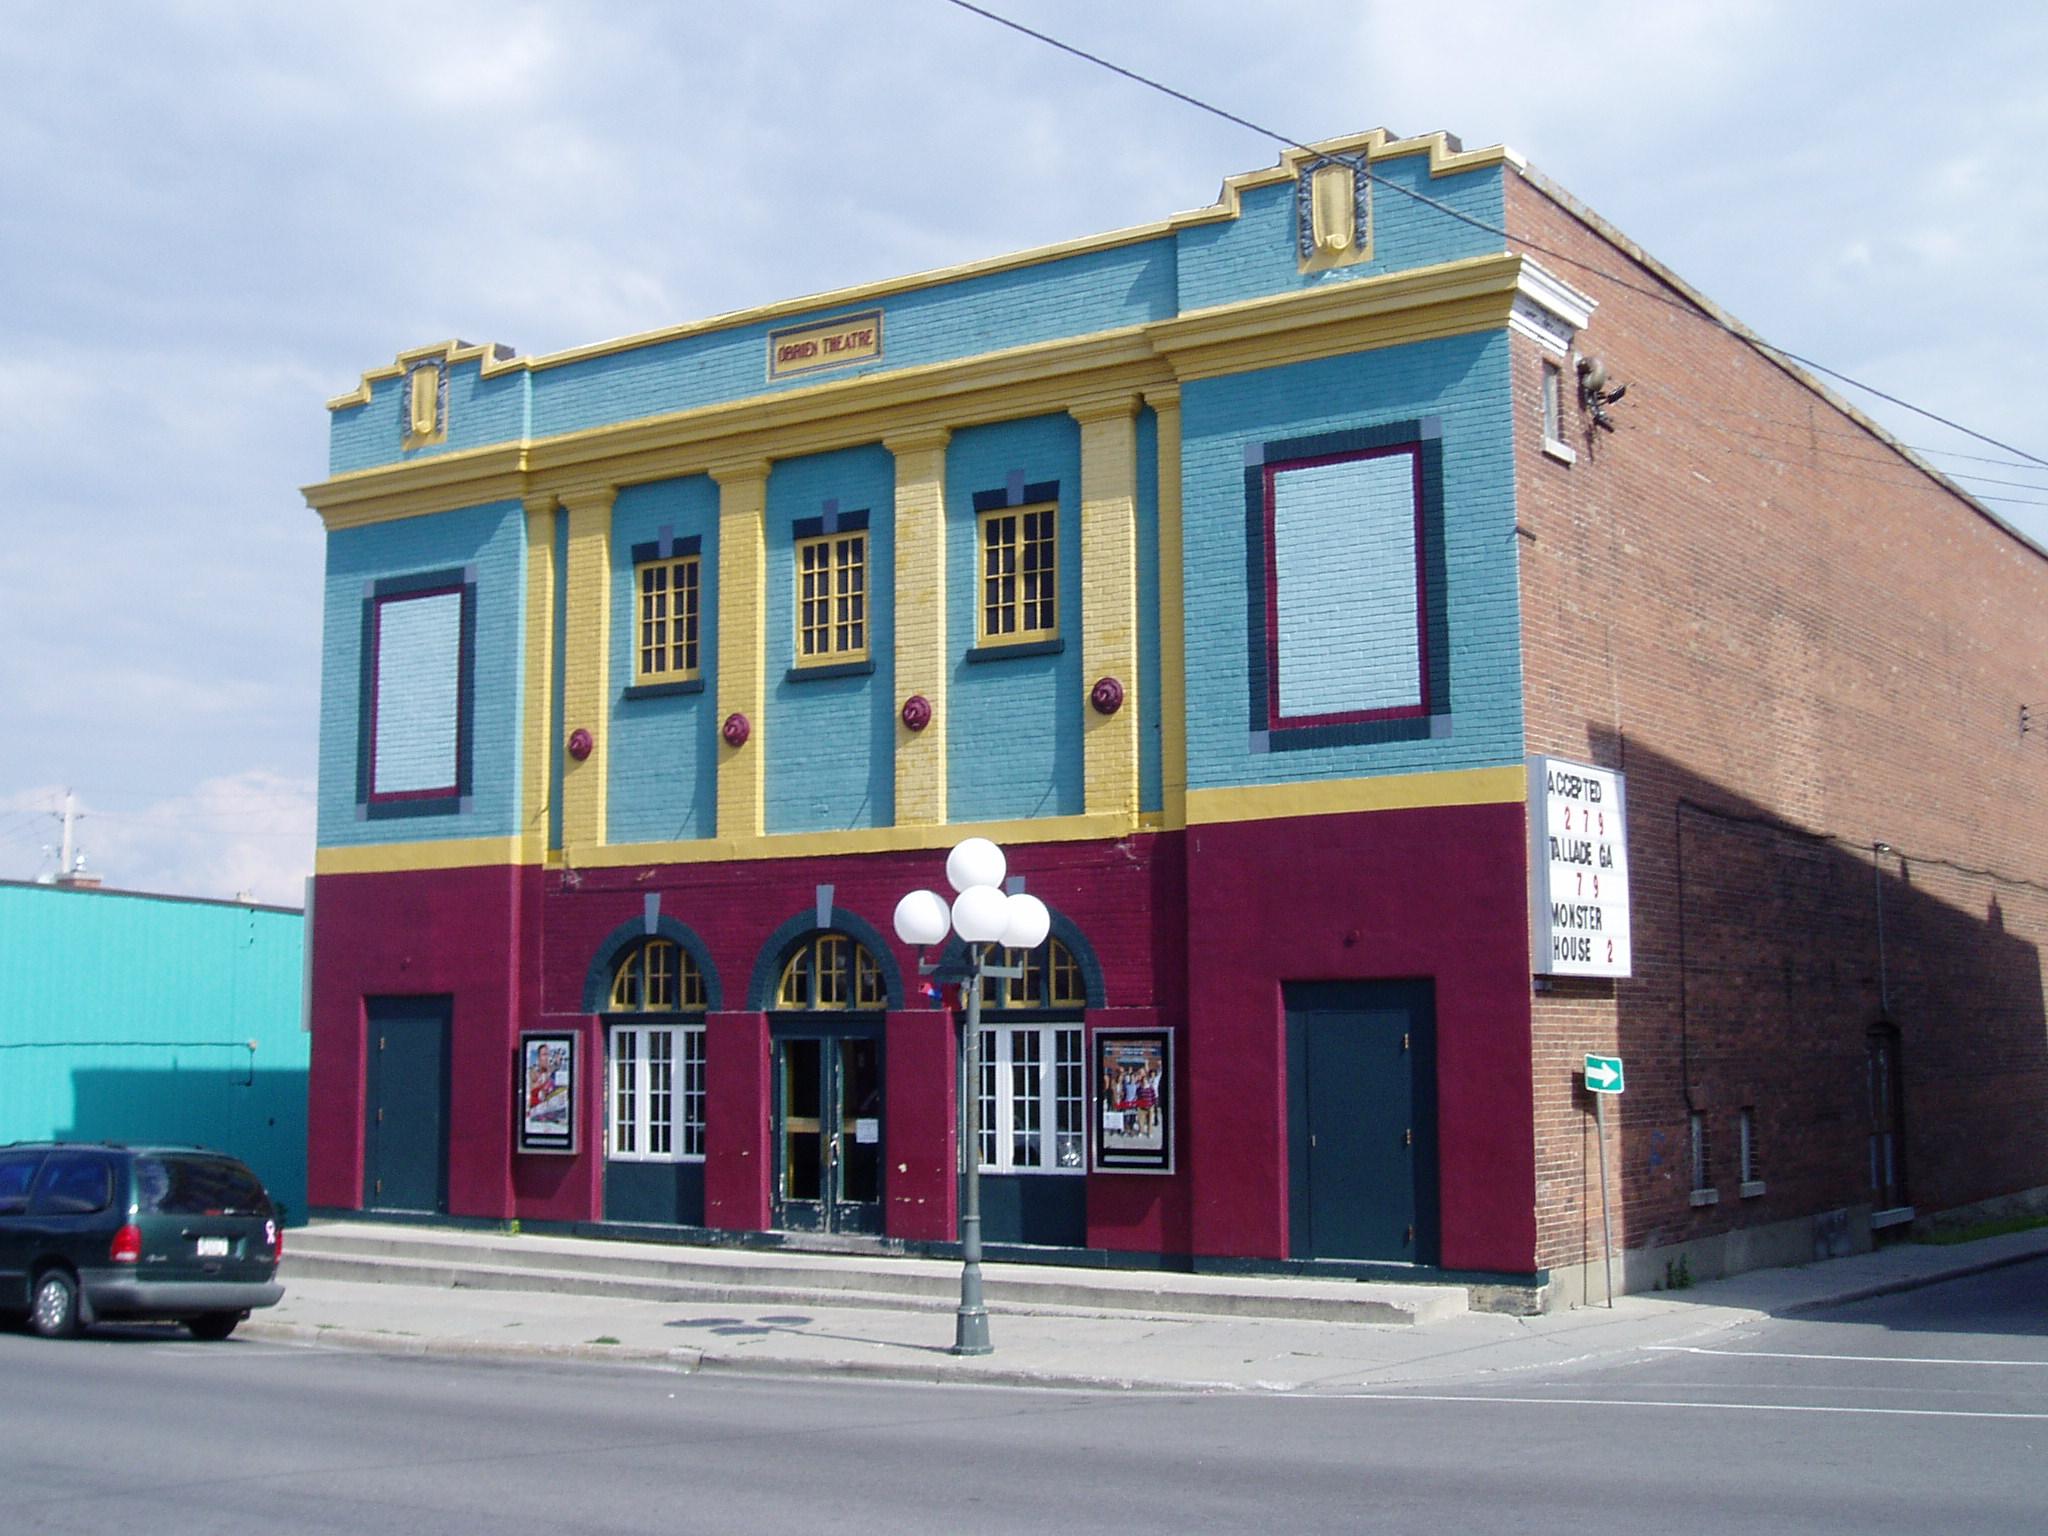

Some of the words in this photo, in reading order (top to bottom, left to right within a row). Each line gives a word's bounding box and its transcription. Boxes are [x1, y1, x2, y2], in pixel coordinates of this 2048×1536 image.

[822, 329, 873, 354] THEATRE
[1548, 770, 1602, 803] ACCEPTED
[1564, 806, 1571, 830] 2
[1583, 809, 1589, 833] 7
[1598, 812, 1604, 836] 9
[1599, 844, 1613, 869] GA
[1576, 872, 1582, 896] 7
[1593, 874, 1599, 899] 9
[1551, 902, 1602, 931] MONSTER
[1553, 935, 1591, 962] HOUSE
[1607, 938, 1613, 963] 2
